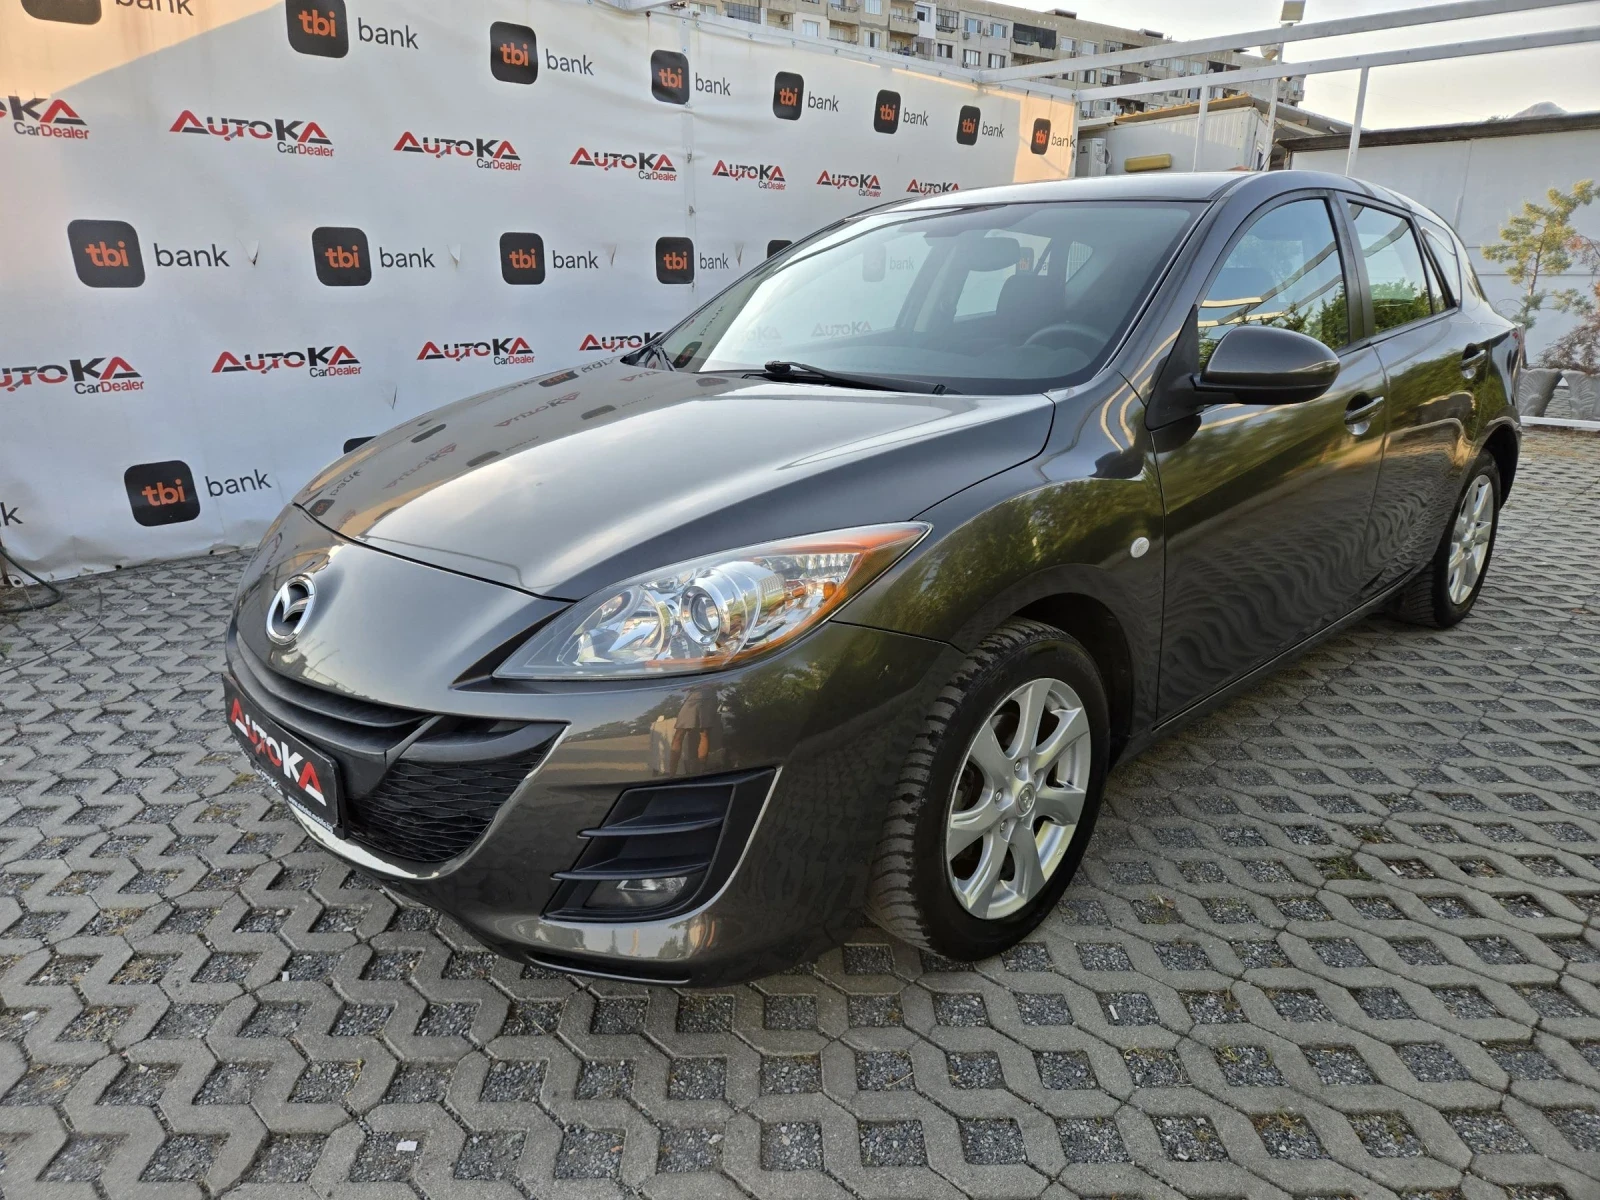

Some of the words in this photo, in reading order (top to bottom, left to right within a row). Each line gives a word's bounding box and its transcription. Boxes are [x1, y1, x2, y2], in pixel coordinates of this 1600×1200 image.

[116, 0, 194, 16] ank
[298, 9, 337, 38] tbi
[357, 17, 419, 50] bank
[500, 41, 530, 67] tbi
[545, 48, 594, 76] bank
[658, 66, 683, 89] tbi
[695, 73, 731, 97] bank
[779, 86, 798, 107] tbi
[807, 92, 839, 112] bank
[0, 96, 87, 125] KA
[879, 104, 896, 122] tbi
[903, 107, 929, 127] bank
[13, 121, 90, 140] CarDealer
[962, 118, 977, 135] tbi
[982, 123, 1005, 138] bank
[1035, 129, 1048, 145] tbi
[1051, 132, 1076, 148] bank
[276, 141, 335, 158] CarDealer
[476, 158, 522, 172] CarDealer
[638, 170, 677, 182] CarDealer
[758, 179, 786, 191] CarDealer
[858, 187, 882, 198] CarDealer
[85, 240, 129, 268] tbi
[153, 242, 231, 267] bank
[324, 245, 360, 269] tbi
[379, 246, 436, 268] bank
[508, 248, 536, 270] tbi
[552, 249, 599, 269] bank
[663, 251, 688, 271] tbi
[699, 252, 730, 270] bank
[493, 354, 535, 366] CarDealer
[309, 365, 362, 378] CarDealer
[74, 379, 145, 395] CarDealer
[141, 478, 186, 507] tbi
[204, 468, 272, 498] bank
